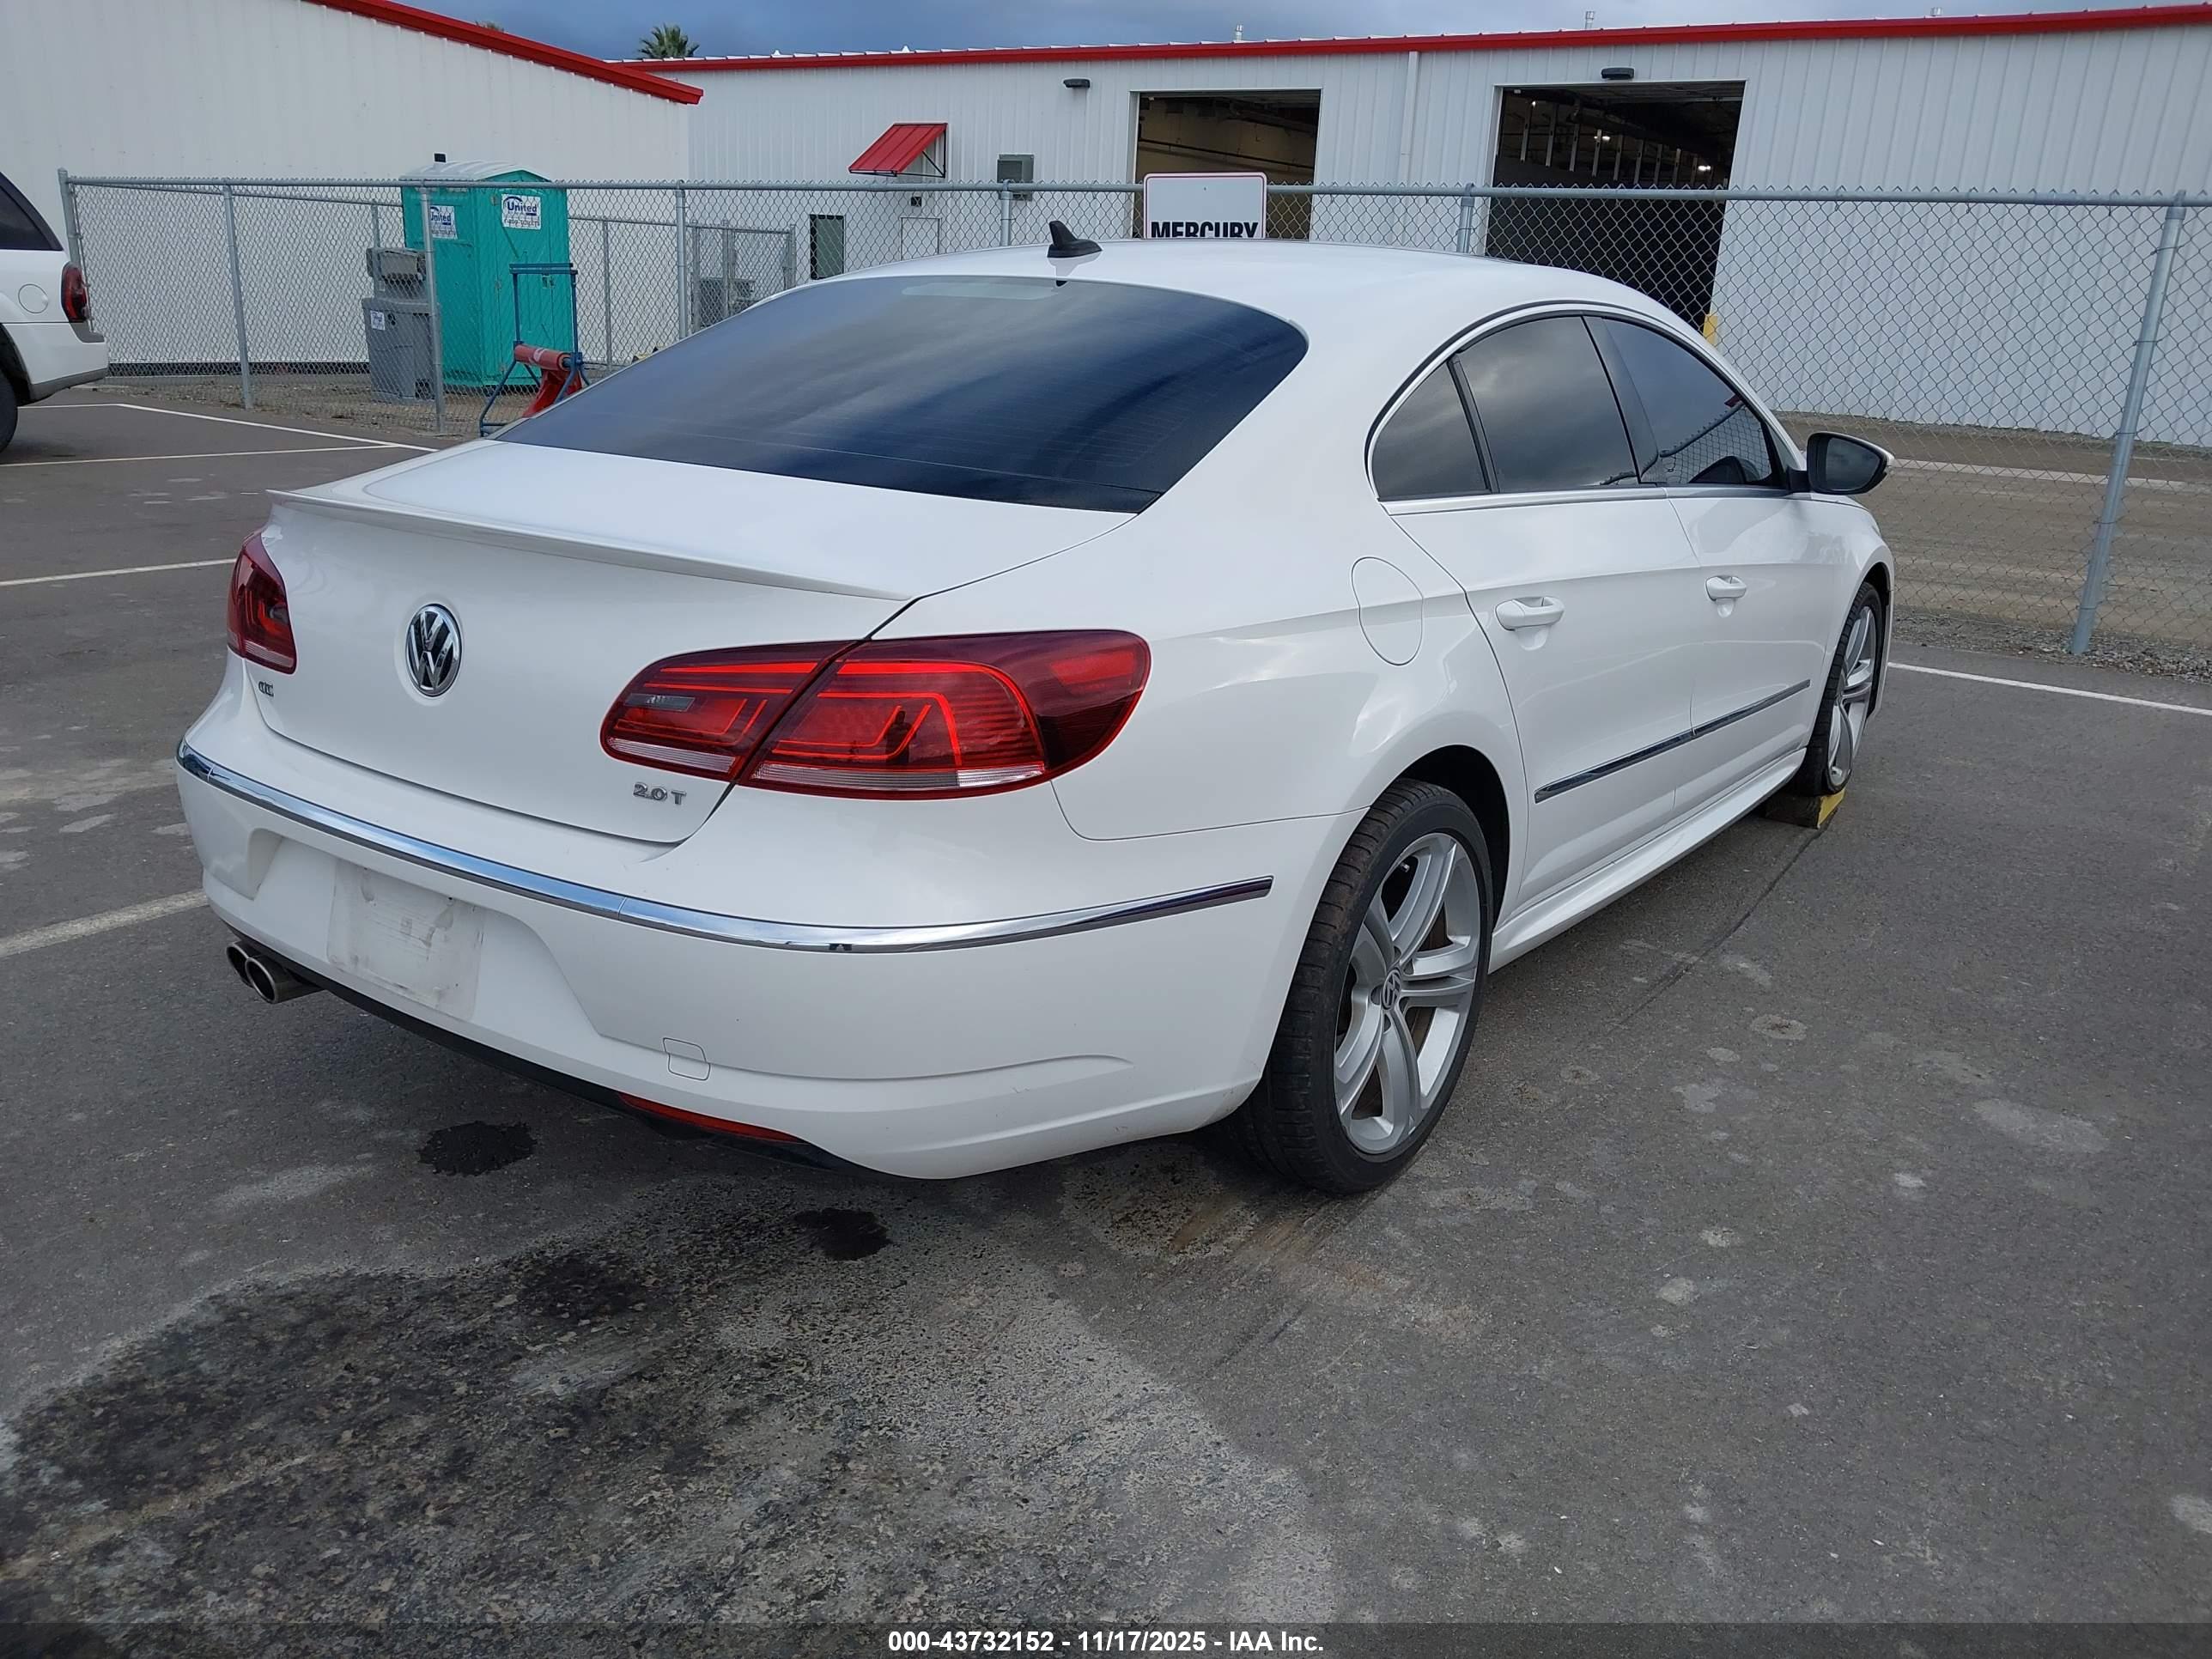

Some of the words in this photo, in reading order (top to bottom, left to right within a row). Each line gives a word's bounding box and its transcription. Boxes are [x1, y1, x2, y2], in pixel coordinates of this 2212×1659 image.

[507, 201, 538, 213] United
[1151, 221, 1259, 238] MERCURY
[405, 605, 461, 696] VW
